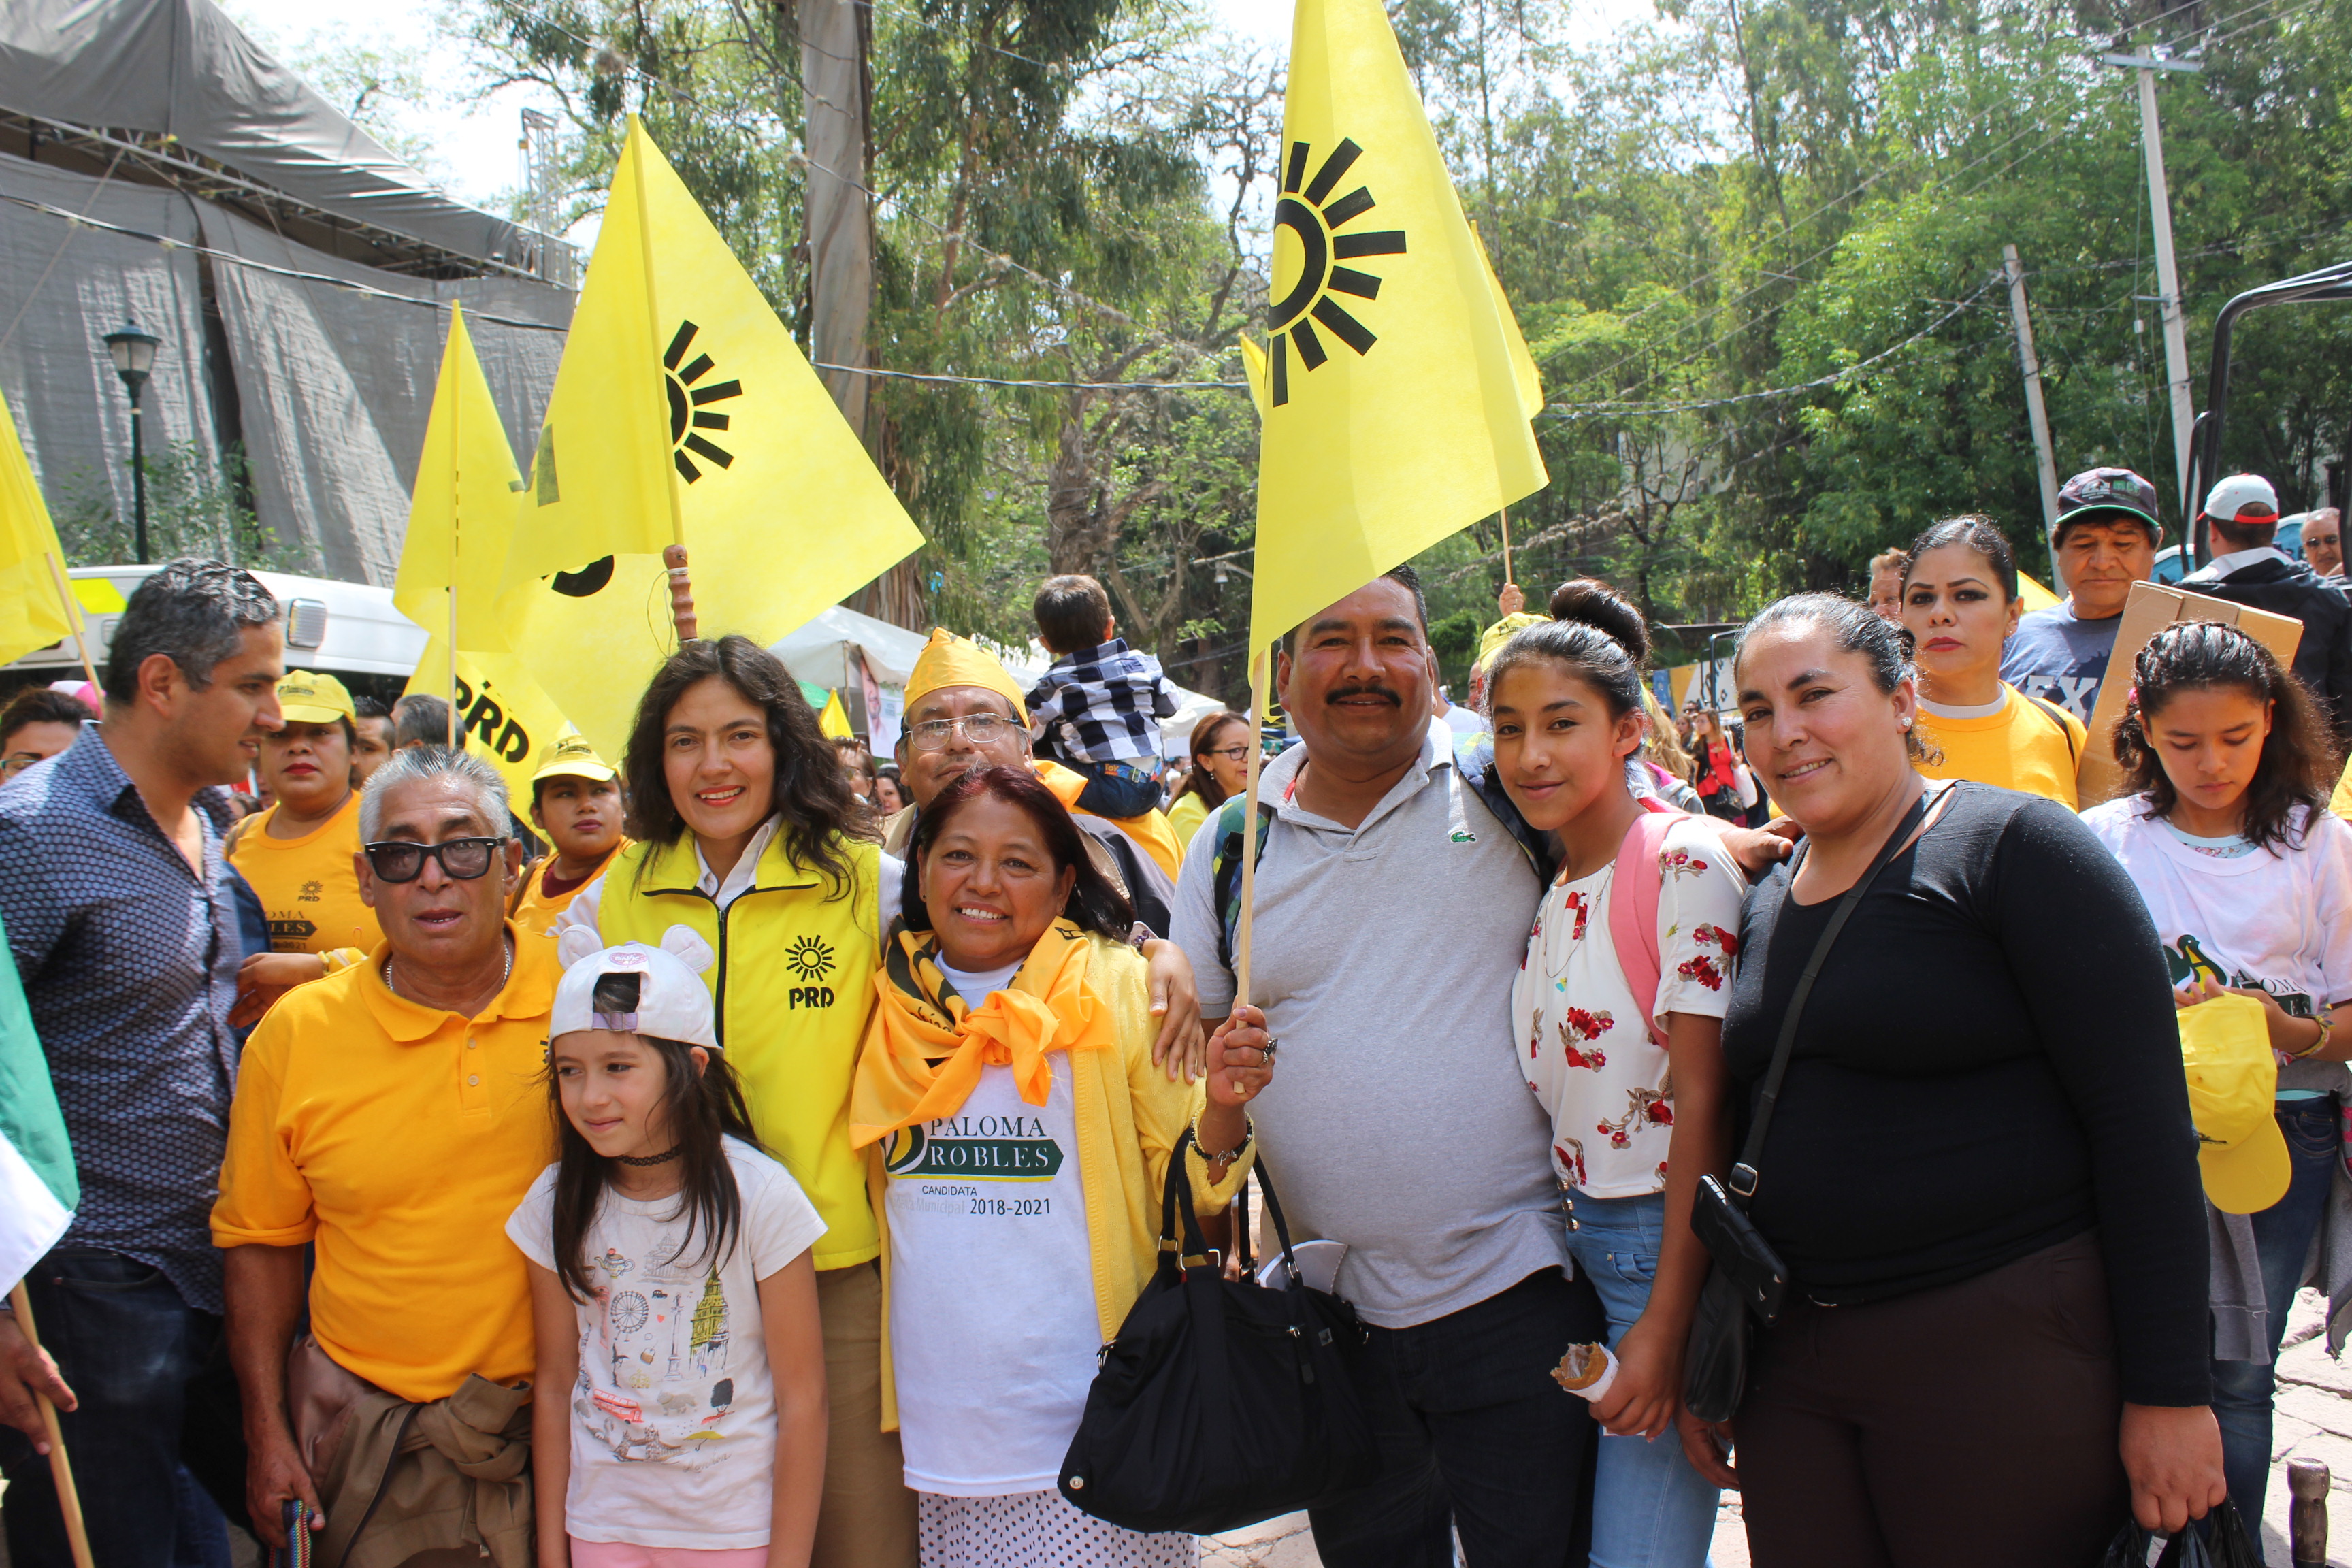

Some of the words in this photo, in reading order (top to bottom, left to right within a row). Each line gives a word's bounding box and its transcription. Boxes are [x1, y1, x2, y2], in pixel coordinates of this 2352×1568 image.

[455, 674, 529, 763] PRD
[265, 910, 304, 919] OMA
[270, 923, 306, 933] LES
[789, 987, 834, 1010] PRD
[930, 1116, 1047, 1137] PALOMA
[930, 1146, 1049, 1168] ROBLES
[921, 1185, 977, 1196] CANDIDATA
[917, 1197, 965, 1217] Municipal
[970, 1198, 1051, 1215] 2018-2021
